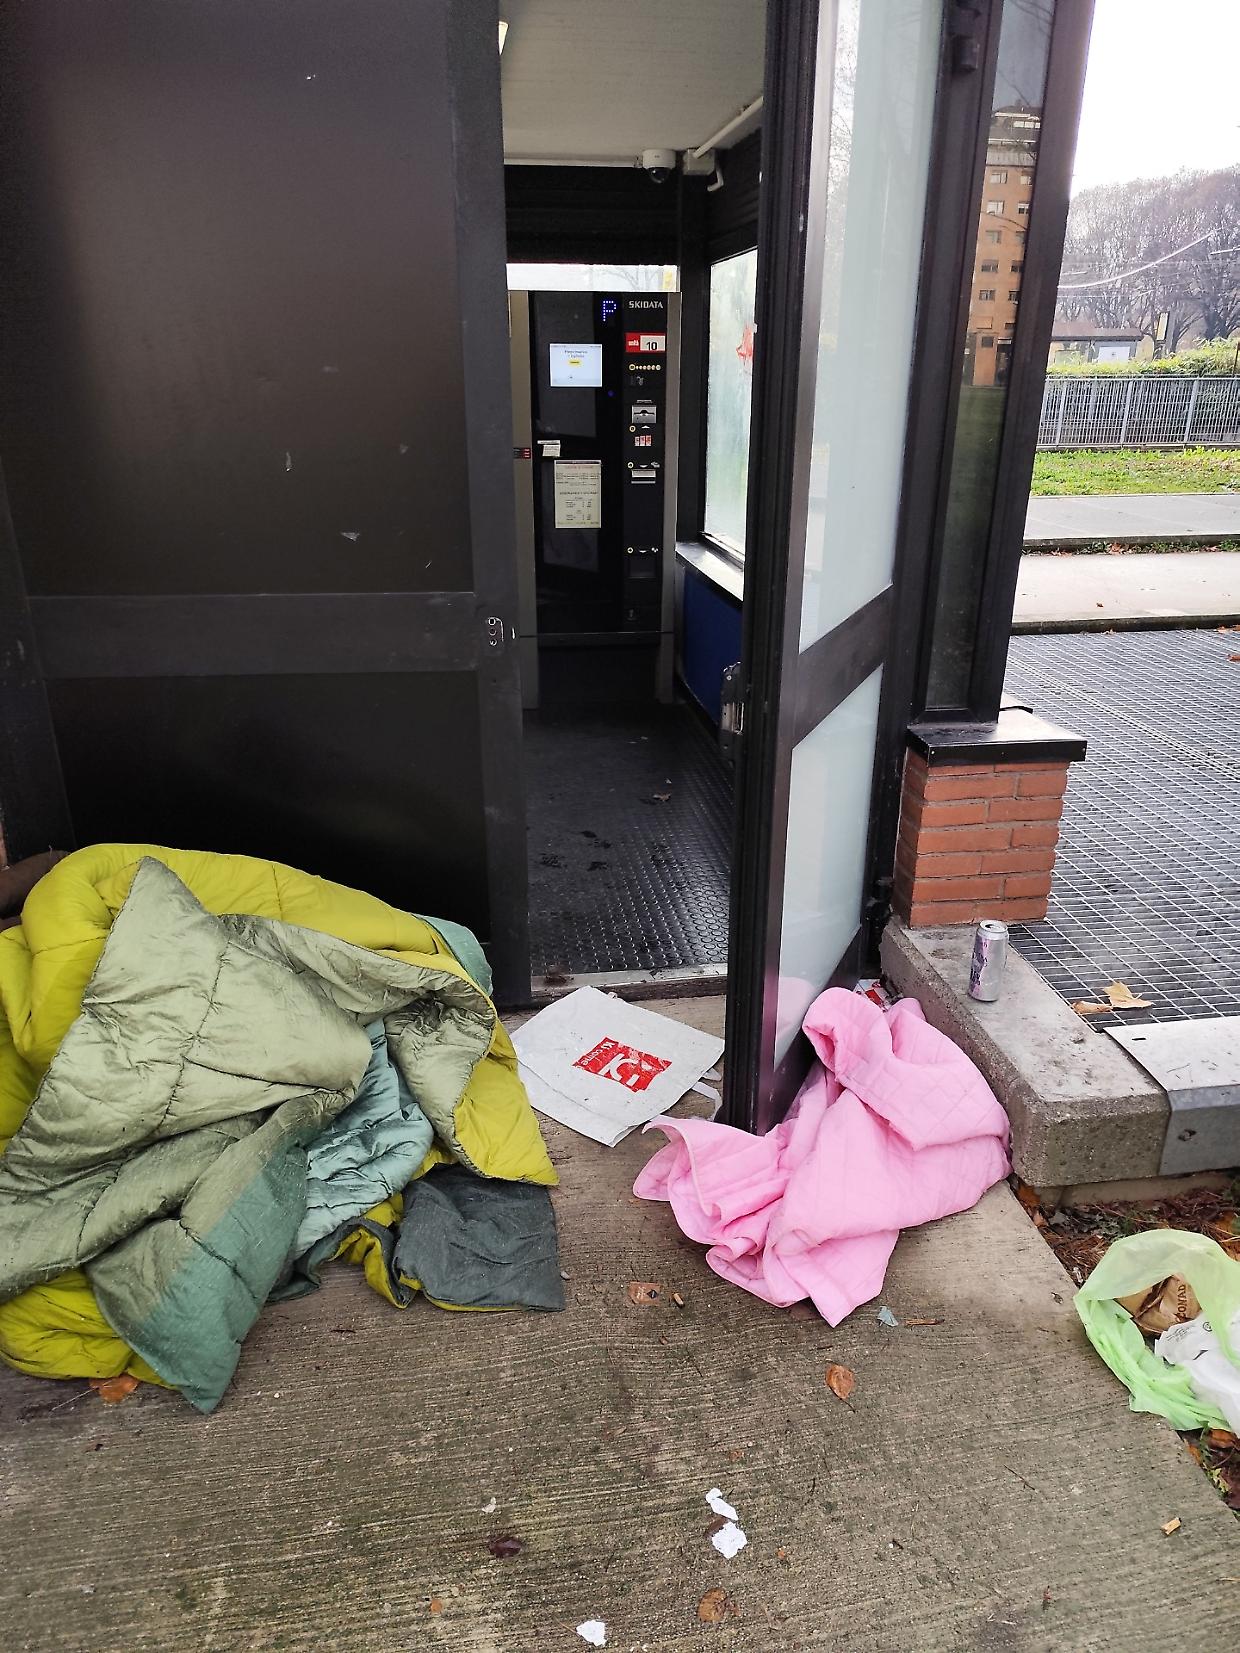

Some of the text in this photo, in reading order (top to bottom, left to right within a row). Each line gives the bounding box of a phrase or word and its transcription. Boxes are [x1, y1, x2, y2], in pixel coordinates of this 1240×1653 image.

[628, 300, 664, 309] SKIDATA
[603, 300, 617, 322] P
[646, 341, 658, 351] 10
